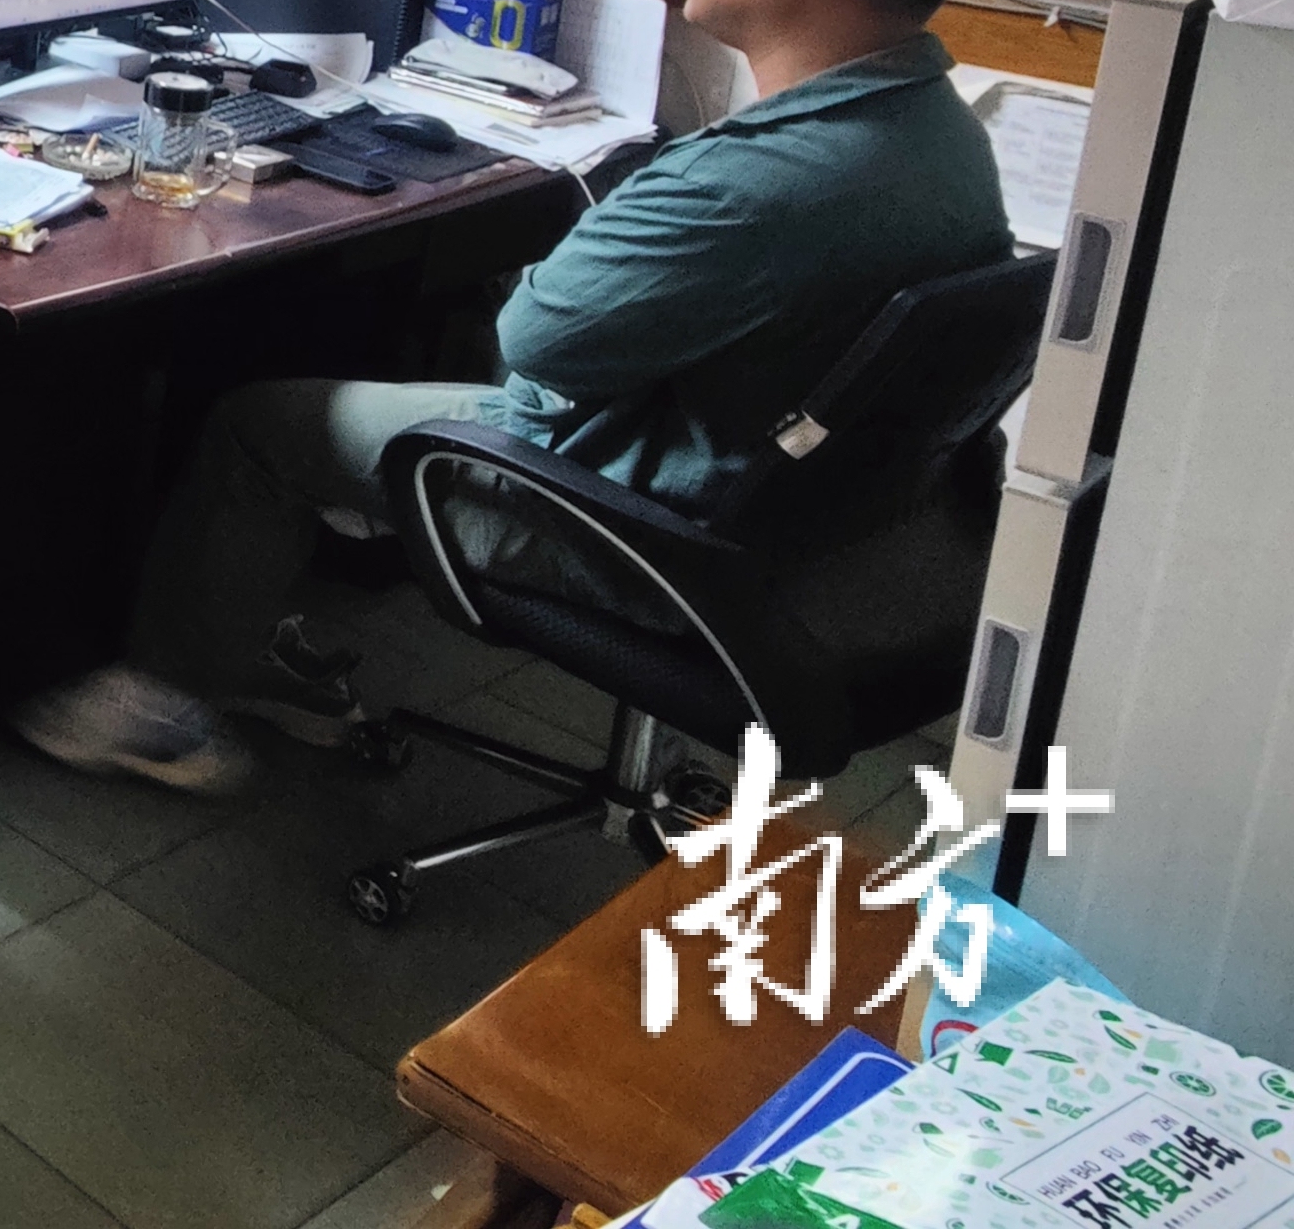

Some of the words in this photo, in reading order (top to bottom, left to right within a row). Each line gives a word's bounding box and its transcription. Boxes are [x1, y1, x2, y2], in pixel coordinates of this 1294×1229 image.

[1037, 1174, 1075, 1200] HUAN
[1070, 1159, 1102, 1181] BAO
[1100, 1145, 1126, 1163] FU
[1123, 1128, 1154, 1147] YIN
[1151, 1112, 1180, 1132] ZHI
[1062, 1124, 1246, 1229] 环保复印纸
